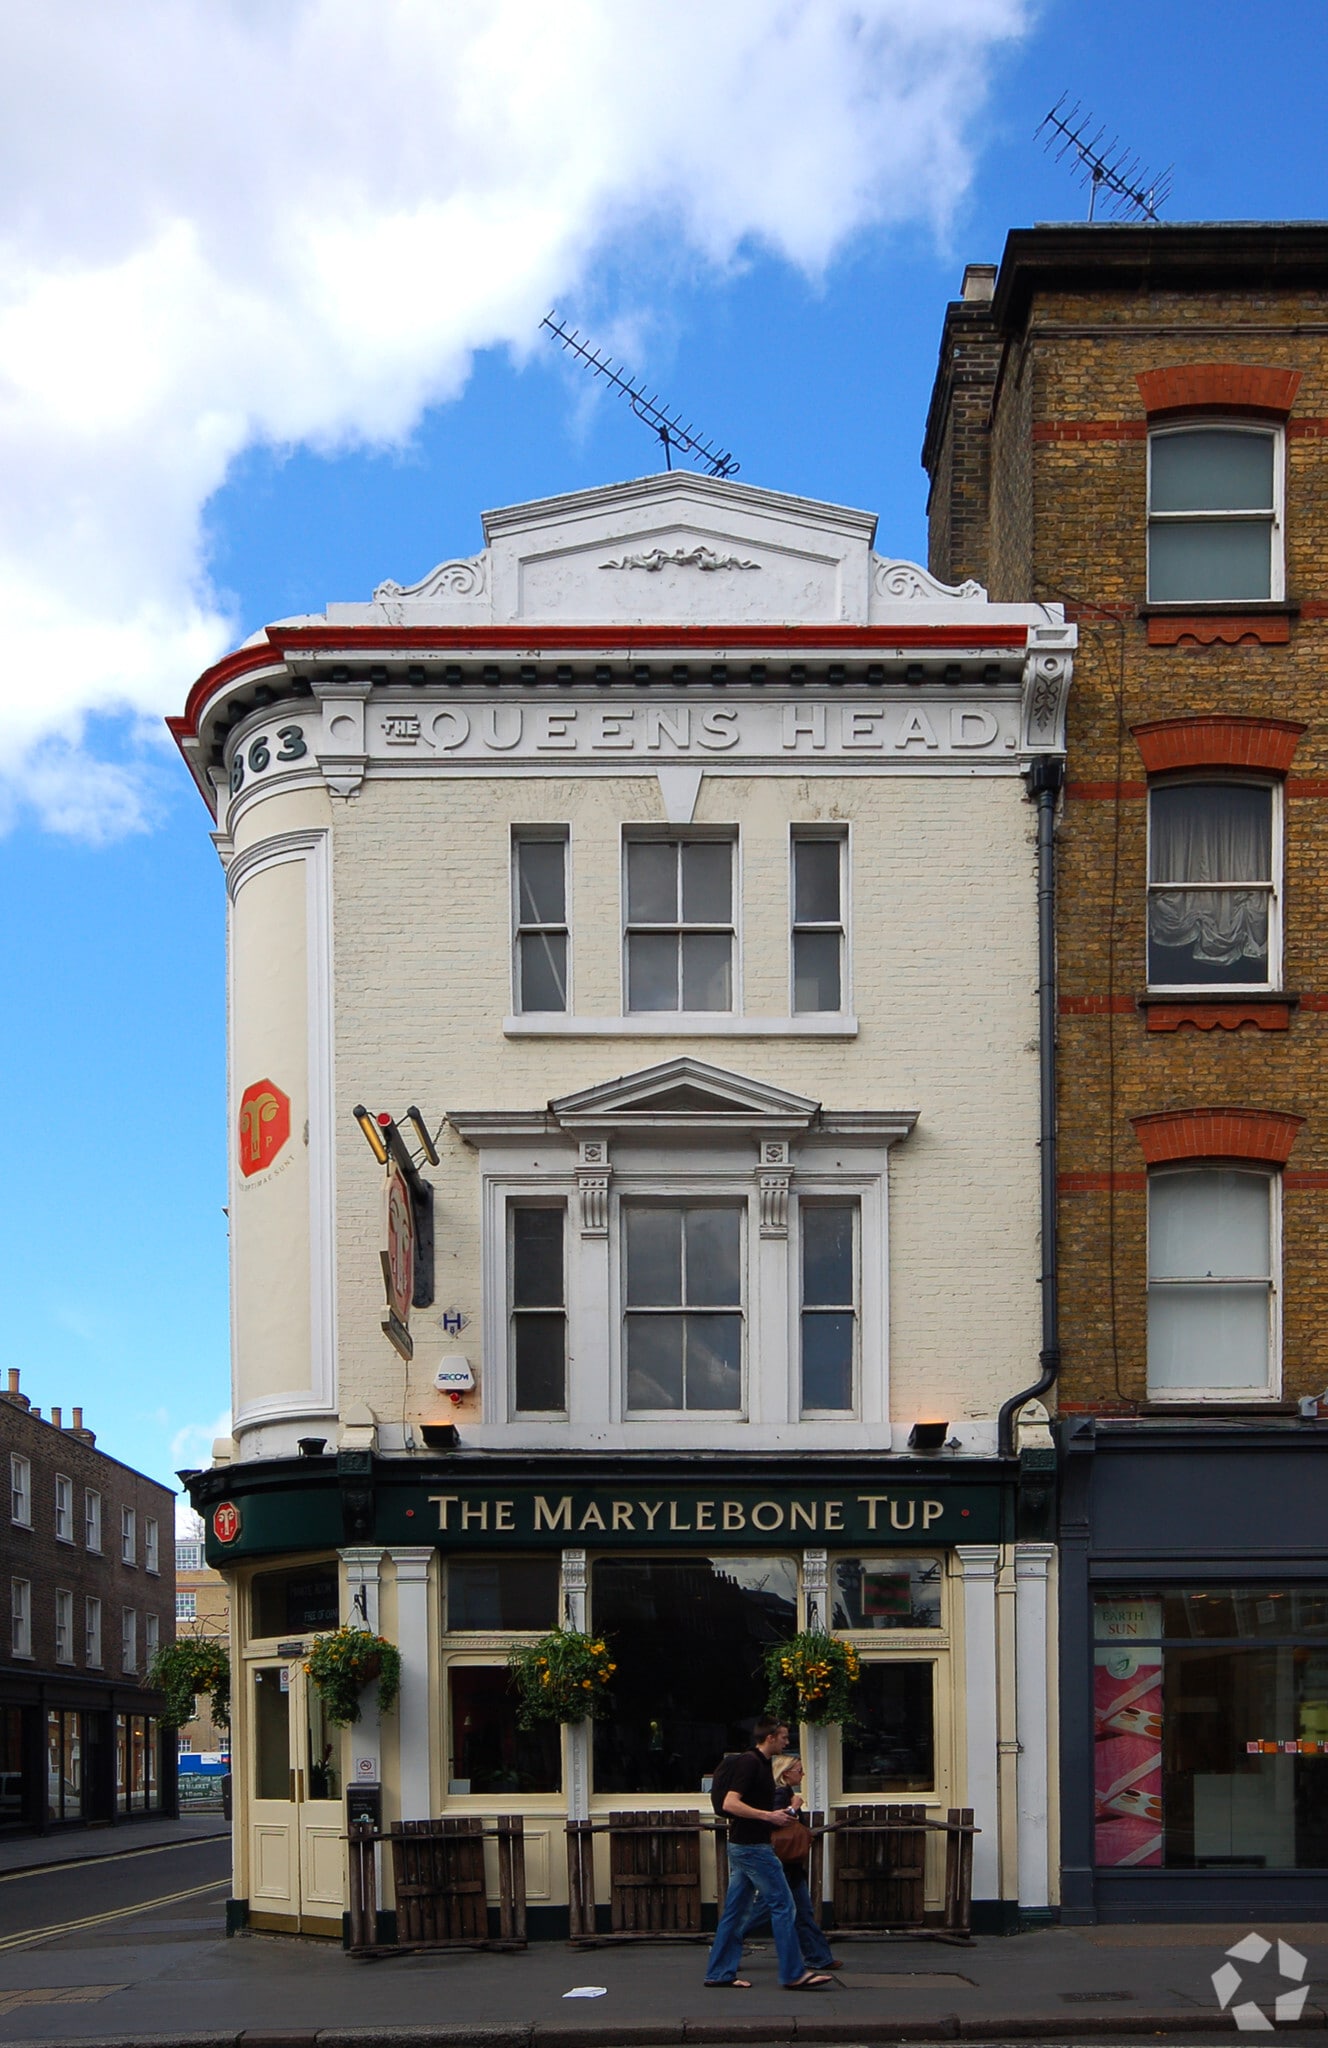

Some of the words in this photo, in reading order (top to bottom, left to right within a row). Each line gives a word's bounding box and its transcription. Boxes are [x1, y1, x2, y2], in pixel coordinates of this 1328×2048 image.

[381, 718, 420, 738] THE
[422, 706, 740, 752] QUEENS
[443, 1313, 461, 1330] H
[438, 1373, 469, 1381] SECOM
[428, 1495, 516, 1530] THE
[533, 1495, 845, 1531] MARYLEBONE
[857, 1495, 944, 1530] TUP
[1103, 1611, 1144, 1621] EARTH
[1108, 1623, 1137, 1634] SUN
